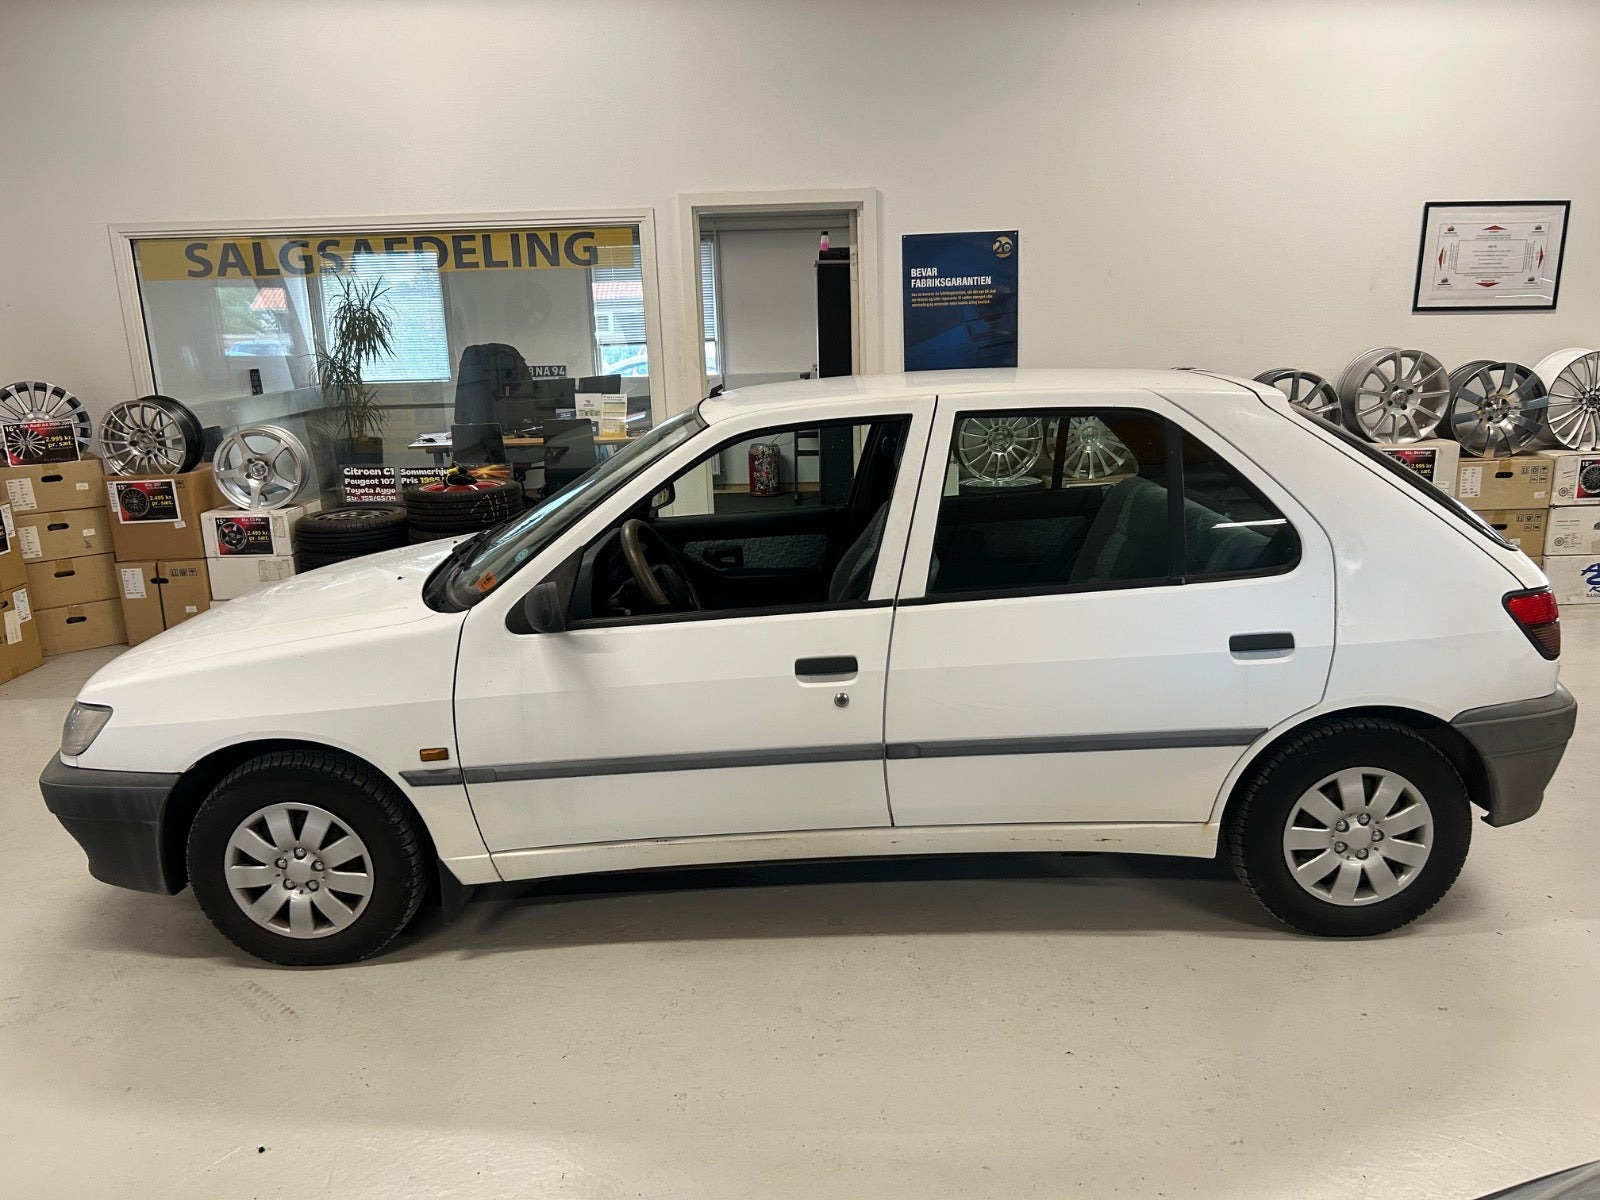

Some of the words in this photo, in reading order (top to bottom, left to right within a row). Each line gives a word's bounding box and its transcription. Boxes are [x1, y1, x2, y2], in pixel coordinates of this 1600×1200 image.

[910, 267, 938, 277] BEVAR
[911, 276, 992, 288] FABRIKSGARANTIEN
[343, 467, 382, 476] Citroen
[383, 467, 395, 476] C1
[400, 467, 449, 476] Sommerhju
[344, 478, 379, 486] Peugeot
[401, 476, 419, 484] Pris
[345, 487, 374, 495] Toyota
[375, 487, 396, 495] Aygo
